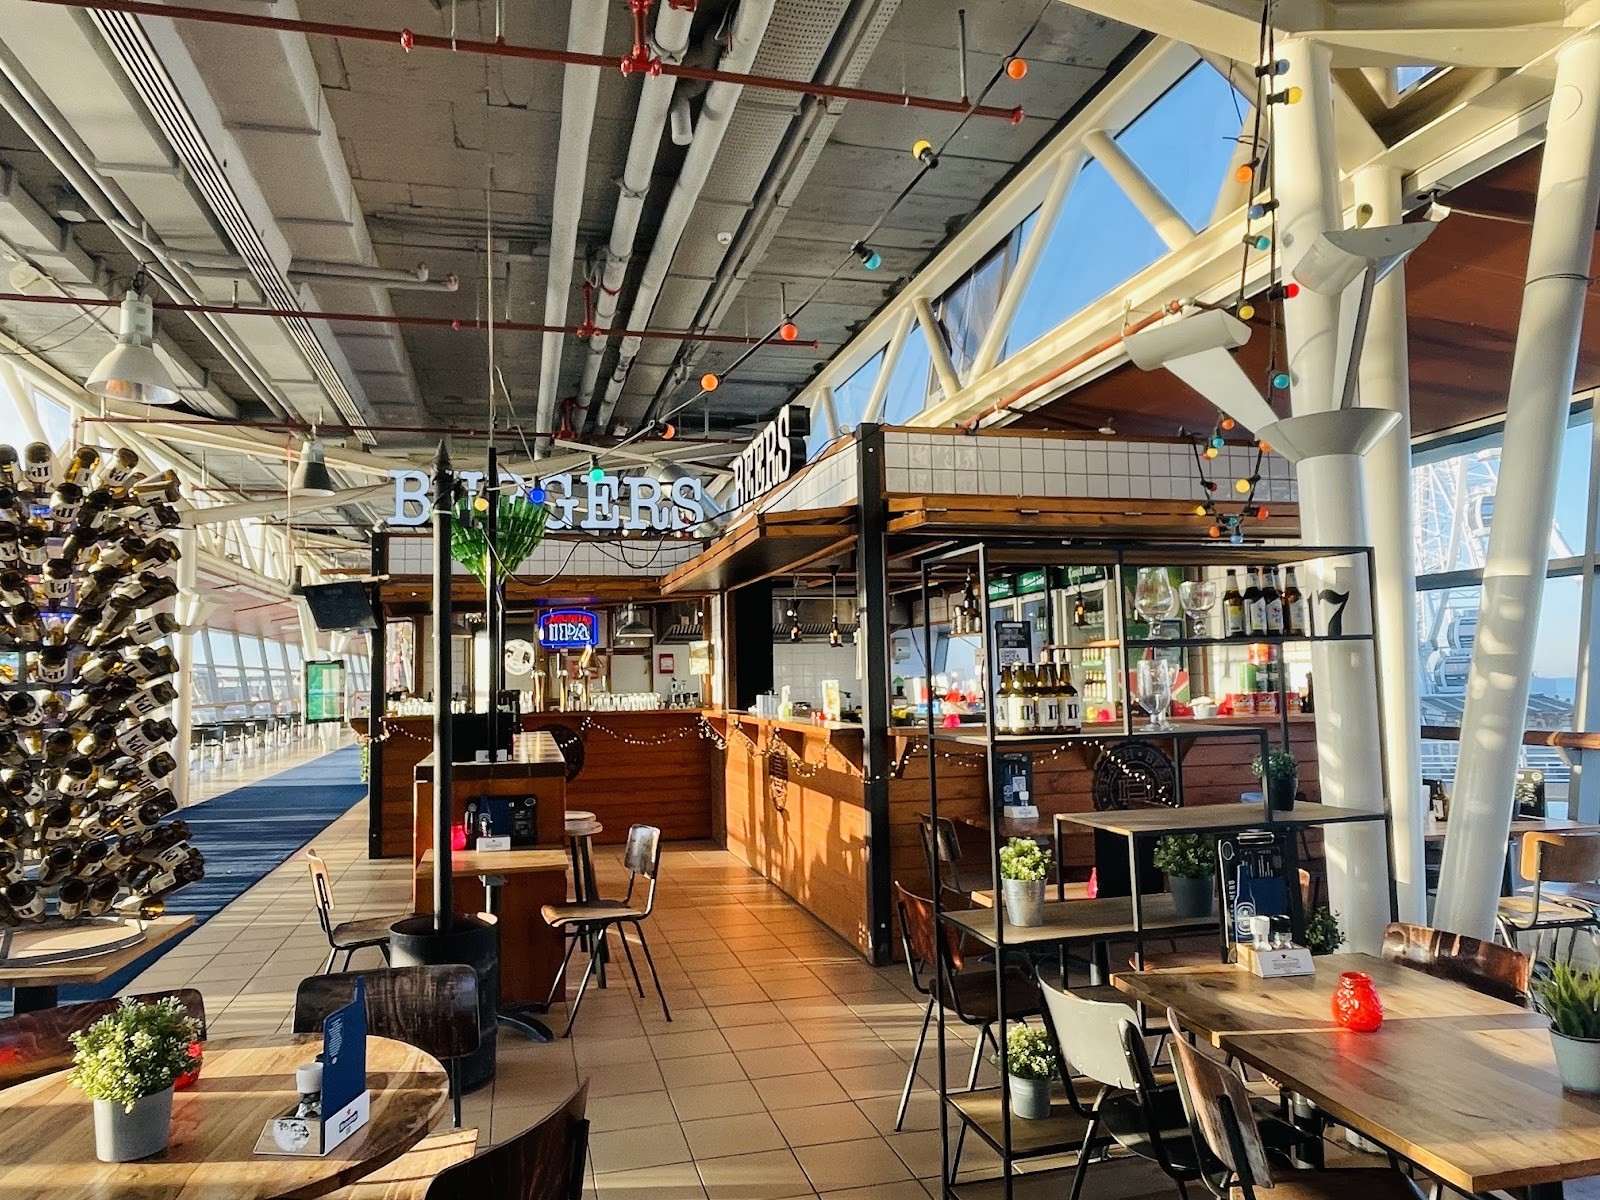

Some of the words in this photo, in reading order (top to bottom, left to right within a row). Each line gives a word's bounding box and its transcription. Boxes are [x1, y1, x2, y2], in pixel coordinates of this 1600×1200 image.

[733, 404, 791, 507] BEERS
[549, 623, 591, 641] IPA
[1317, 588, 1350, 636] 7
